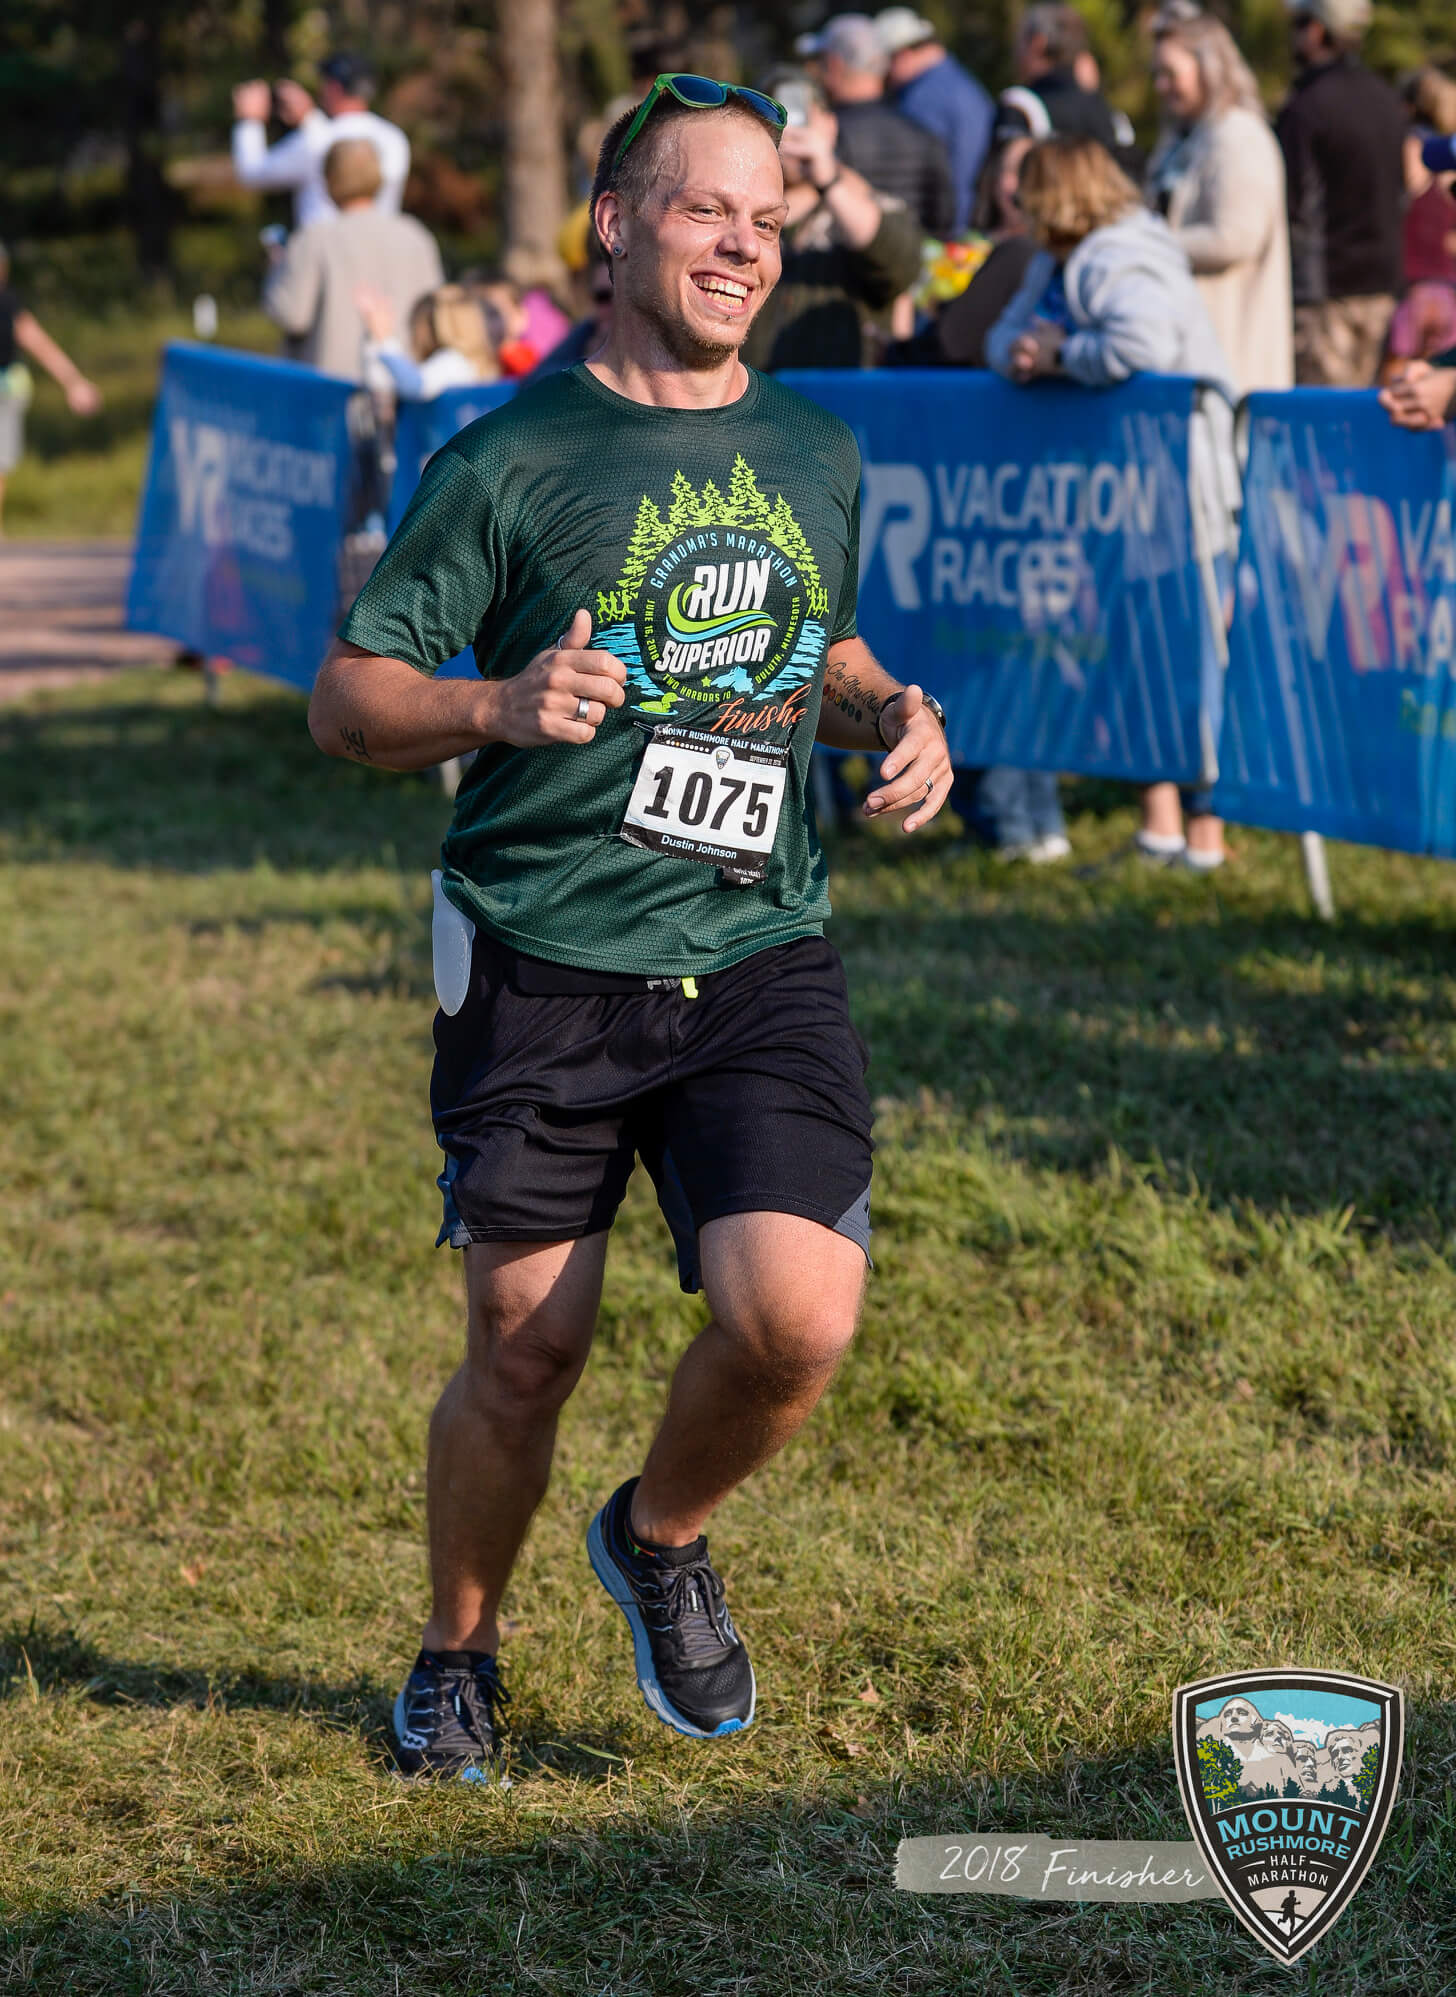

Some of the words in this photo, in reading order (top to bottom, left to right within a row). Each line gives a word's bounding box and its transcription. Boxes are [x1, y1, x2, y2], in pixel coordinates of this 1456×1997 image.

[934, 462, 1157, 536] VACATION
[649, 532, 719, 590] GRANDMA'S
[726, 531, 799, 589] MARATHON
[644, 598, 657, 623] JUNE
[687, 558, 772, 619] RUN
[645, 638, 661, 661] 2018
[654, 628, 772, 674] SUPERIOR
[662, 672, 680, 690] TWO
[679, 685, 721, 703] HARBORS
[754, 653, 785, 685] DULUTH,
[780, 596, 801, 650] MINNESOTA
[662, 727, 687, 737] MOUNT
[688, 730, 730, 746] RUSHMORE
[730, 738, 749, 750] HALF
[750, 742, 785, 756] MARATHON
[643, 765, 774, 838] 1075
[660, 834, 695, 851] Dustin
[696, 843, 737, 860] Johnson
